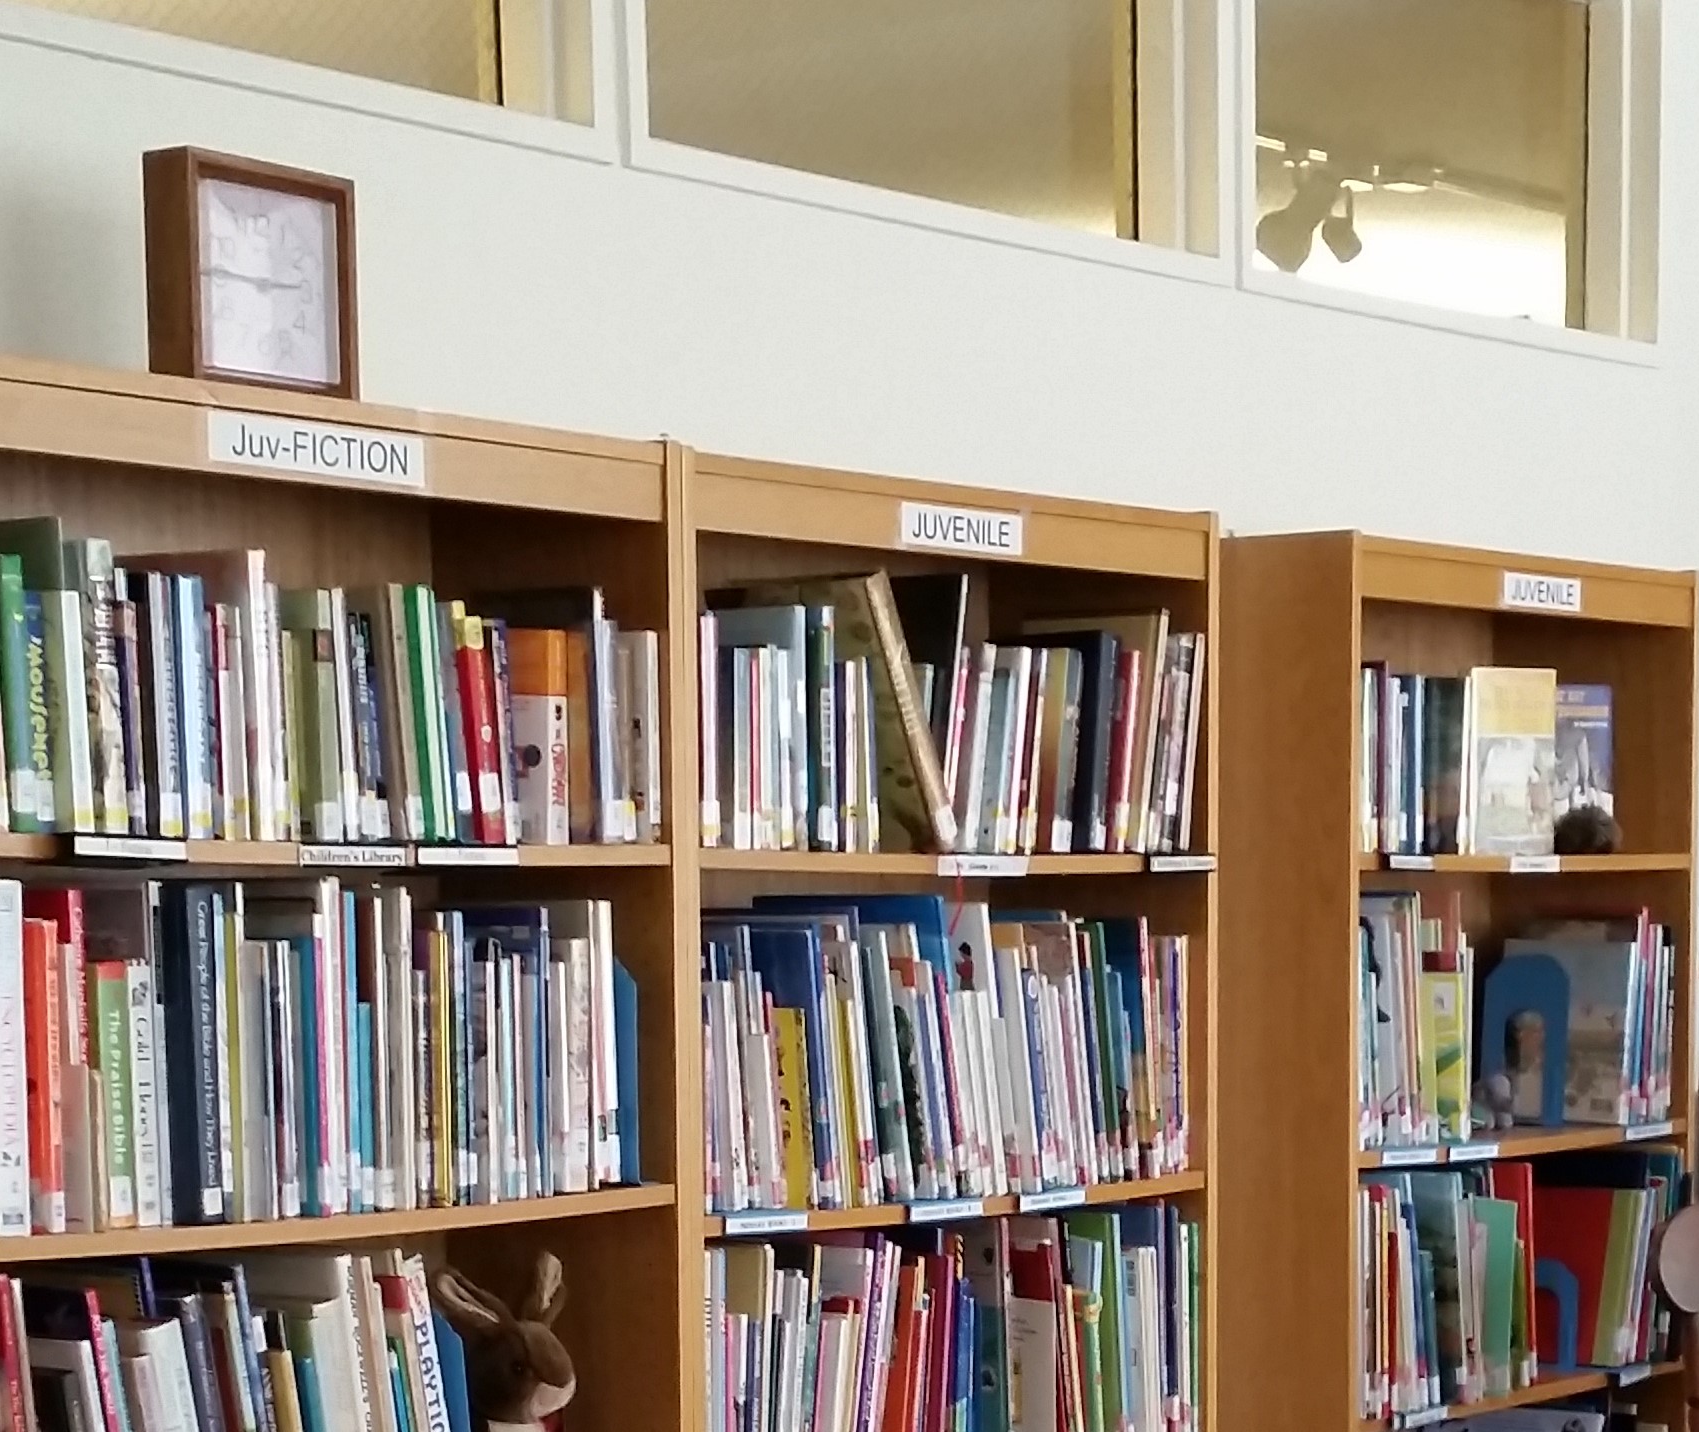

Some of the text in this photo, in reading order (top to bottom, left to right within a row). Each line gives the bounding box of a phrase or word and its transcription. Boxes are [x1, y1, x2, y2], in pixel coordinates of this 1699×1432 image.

[232, 424, 410, 478] Juv-FICTION
[912, 511, 1011, 548] JUVENILE
[1511, 576, 1576, 606] JUVENILE
[301, 848, 404, 867] Children's Library
[197, 901, 218, 1185] Great People of the Bible and How They Lived
[1, 996, 23, 1147] ENCYCLOPEDIA
[107, 1010, 125, 1164] The Praise Bible
